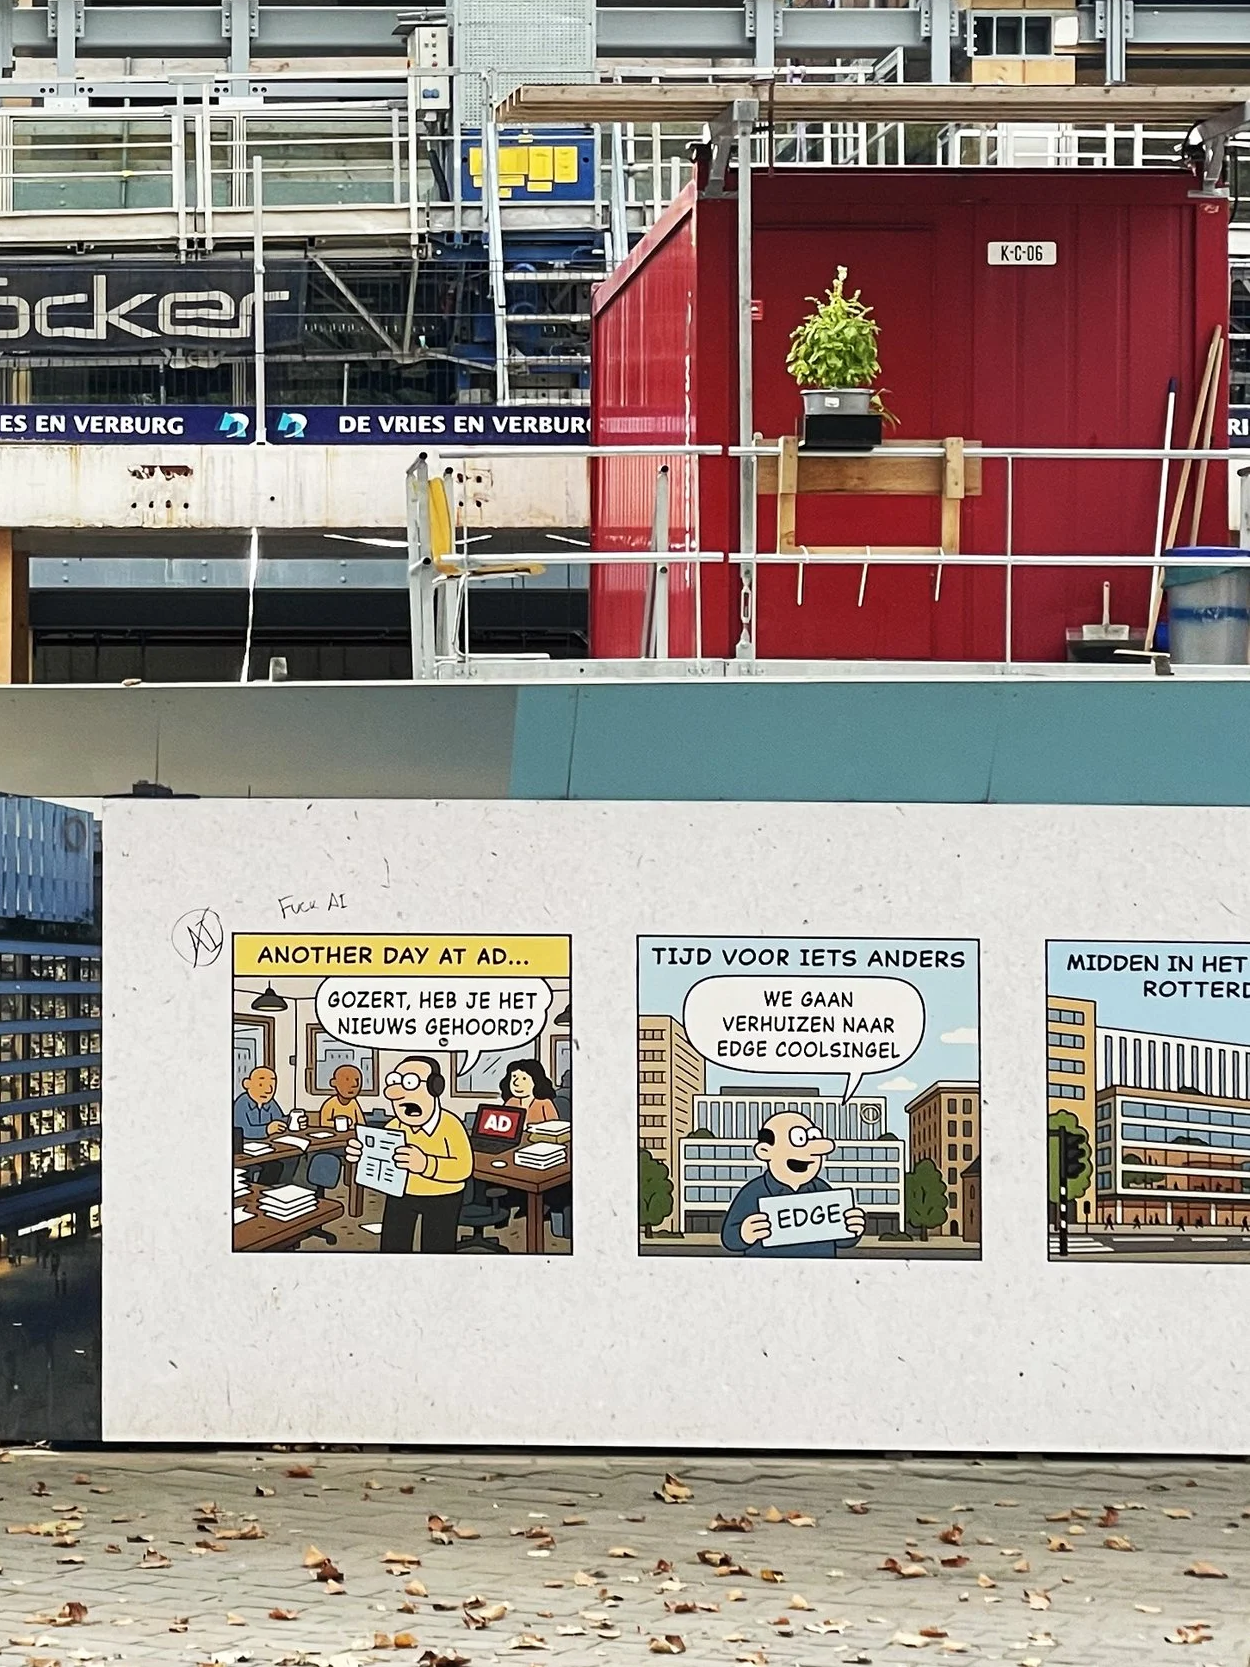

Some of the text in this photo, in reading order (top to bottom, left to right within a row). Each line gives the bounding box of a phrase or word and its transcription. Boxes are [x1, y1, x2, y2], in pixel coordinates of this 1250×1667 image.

[1000, 245, 1043, 262] K-C-06
[36, 415, 65, 433] EN
[73, 415, 184, 435] VERBURG
[339, 416, 591, 434] DE VRIES EN VERBUR
[327, 892, 348, 911] AI
[257, 945, 529, 965] ANOTHER DAY AT AD...
[652, 947, 966, 968] TIJD VOOR IETS ANDERS
[1067, 954, 1249, 973] MIDDEN IN HET
[328, 991, 537, 1011] GOZERT, HEB JE HET
[764, 990, 854, 1008] WE GAAN
[338, 1018, 534, 1036] NIEUWS GEHOORD?
[722, 1016, 895, 1034] VERHUIZEN NAAR
[717, 1040, 900, 1059] EDGE COOLSINGEL
[483, 1114, 512, 1134] AD
[777, 1203, 841, 1229] EDGE
